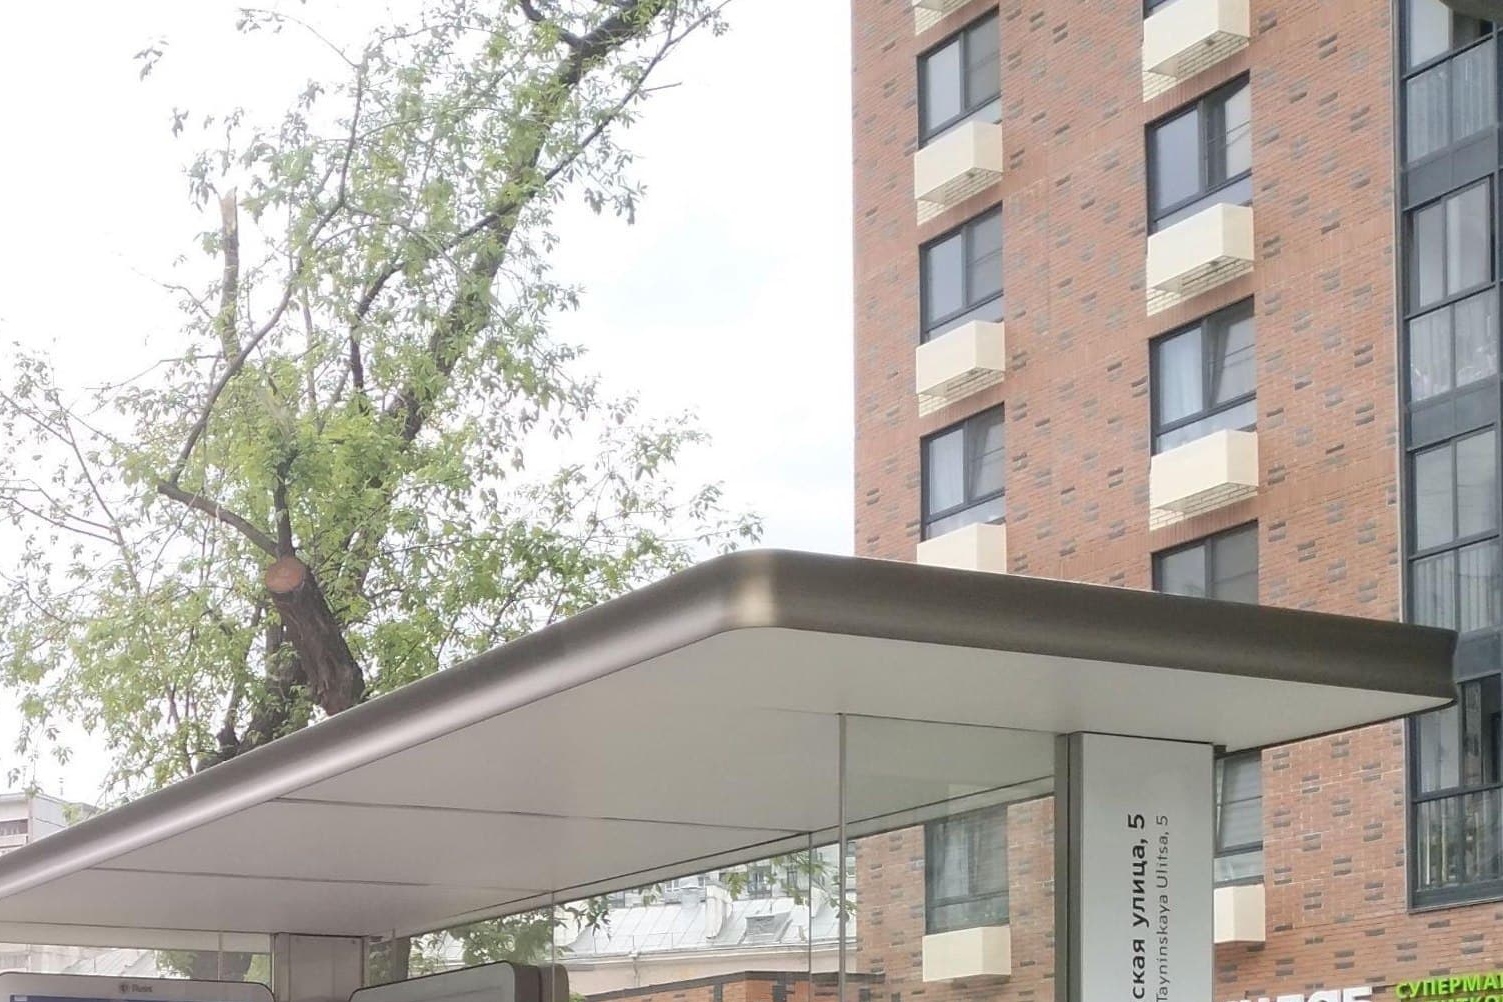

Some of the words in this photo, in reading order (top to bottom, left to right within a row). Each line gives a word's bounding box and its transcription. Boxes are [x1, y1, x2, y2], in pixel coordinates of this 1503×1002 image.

[1127, 813, 1145, 829] 5
[1155, 814, 1168, 826] 5
[1155, 832, 1169, 888] Ulitsa,
[1131, 837, 1149, 928] улица,
[1396, 972, 1503, 998] СУПЕРМА
